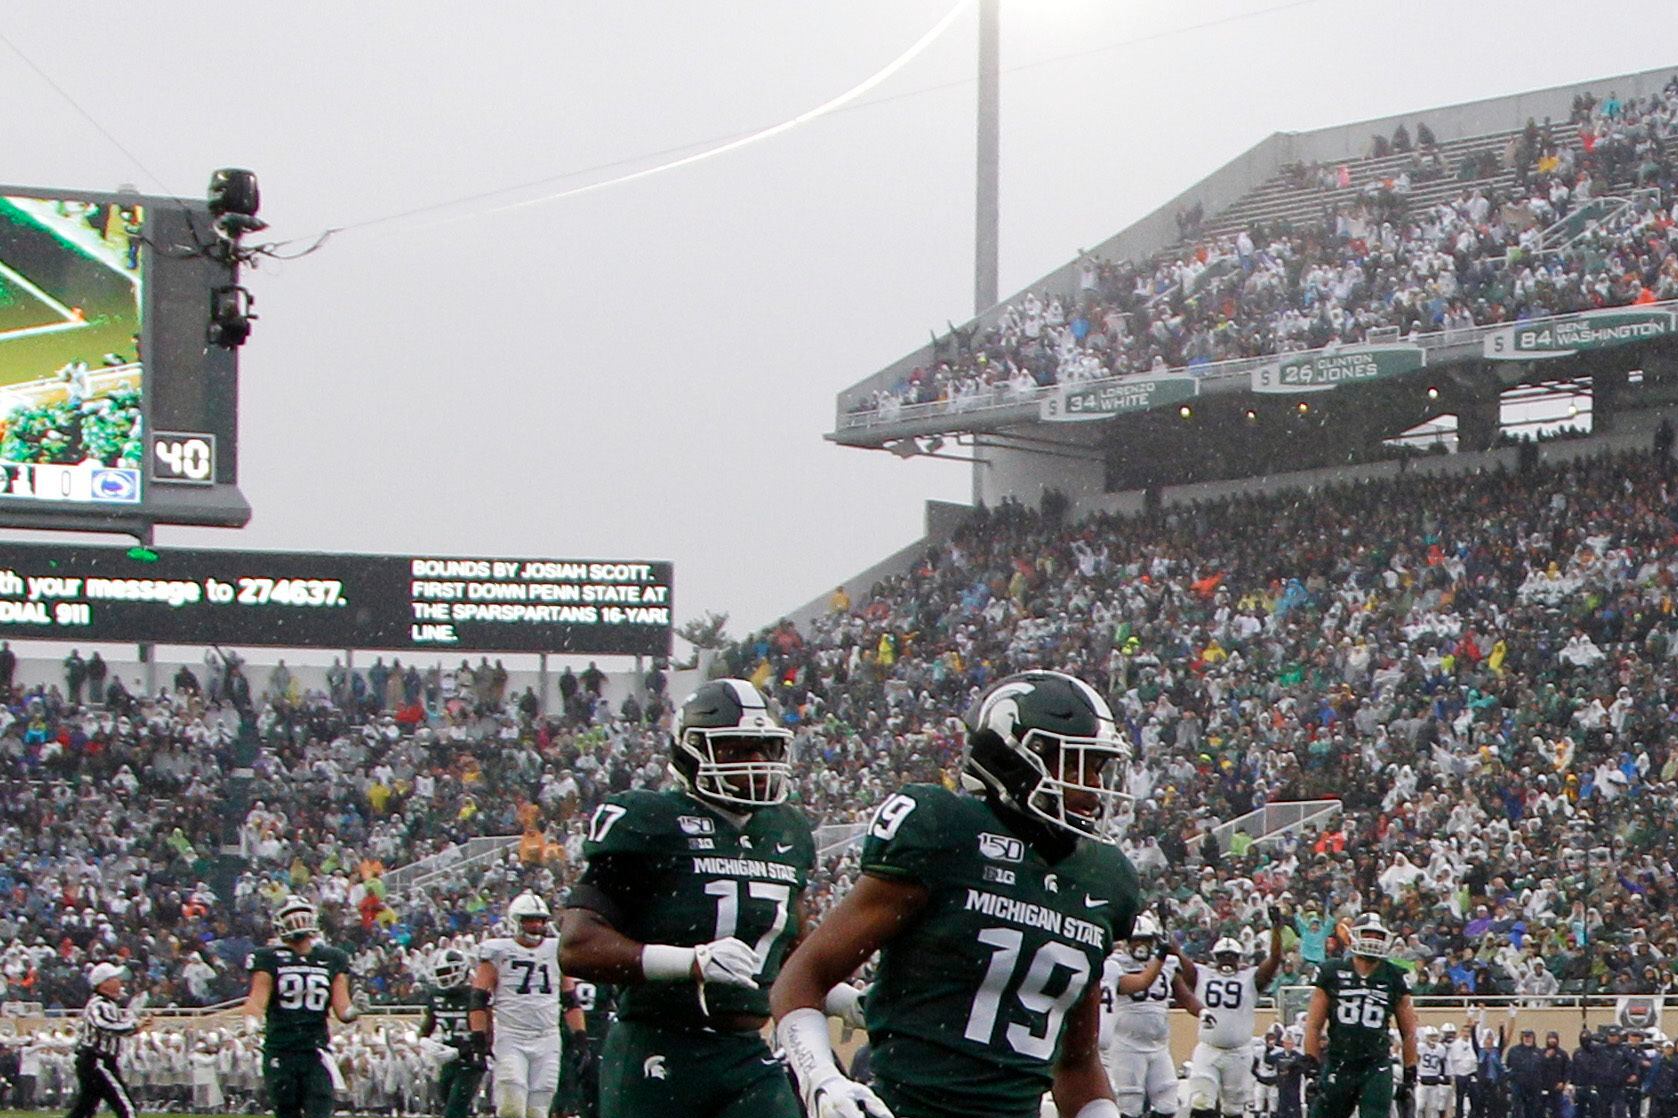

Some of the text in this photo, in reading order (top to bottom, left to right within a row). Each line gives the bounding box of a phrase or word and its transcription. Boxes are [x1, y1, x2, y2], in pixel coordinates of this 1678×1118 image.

[1520, 330, 1553, 348] 84
[1556, 322, 1665, 345] WASHINGTON
[1285, 365, 1312, 383] 26
[1317, 354, 1373, 370] CLINTON
[1317, 364, 1378, 382] JONES
[1100, 383, 1156, 398] LORENZO
[1101, 393, 1149, 410] WHITE
[1070, 395, 1096, 411] 34
[155, 438, 211, 479] 40
[412, 560, 654, 580] BOUNDS BY JOSIAH SCOTT.
[28, 577, 81, 600] your
[85, 577, 200, 606] message
[205, 578, 234, 602] to
[238, 578, 346, 605] 274637.
[412, 581, 667, 602] FIRST DOWN PENN STATE AT
[55, 602, 91, 625] 911
[412, 603, 449, 619] THE
[453, 604, 597, 622] SPARSPARTANS
[412, 624, 458, 641] LINE.
[588, 804, 627, 842] 17
[867, 793, 916, 840] 19
[978, 832, 1025, 863] 150
[693, 857, 798, 883] MICHIGAN STATE
[704, 879, 790, 975] 17
[964, 888, 1105, 950] MICHIGAN STATE
[511, 960, 552, 994] 71
[278, 973, 330, 1011] 96
[963, 928, 1091, 1061] 19
[1205, 980, 1242, 1009] 69
[1337, 996, 1385, 1028] 86
